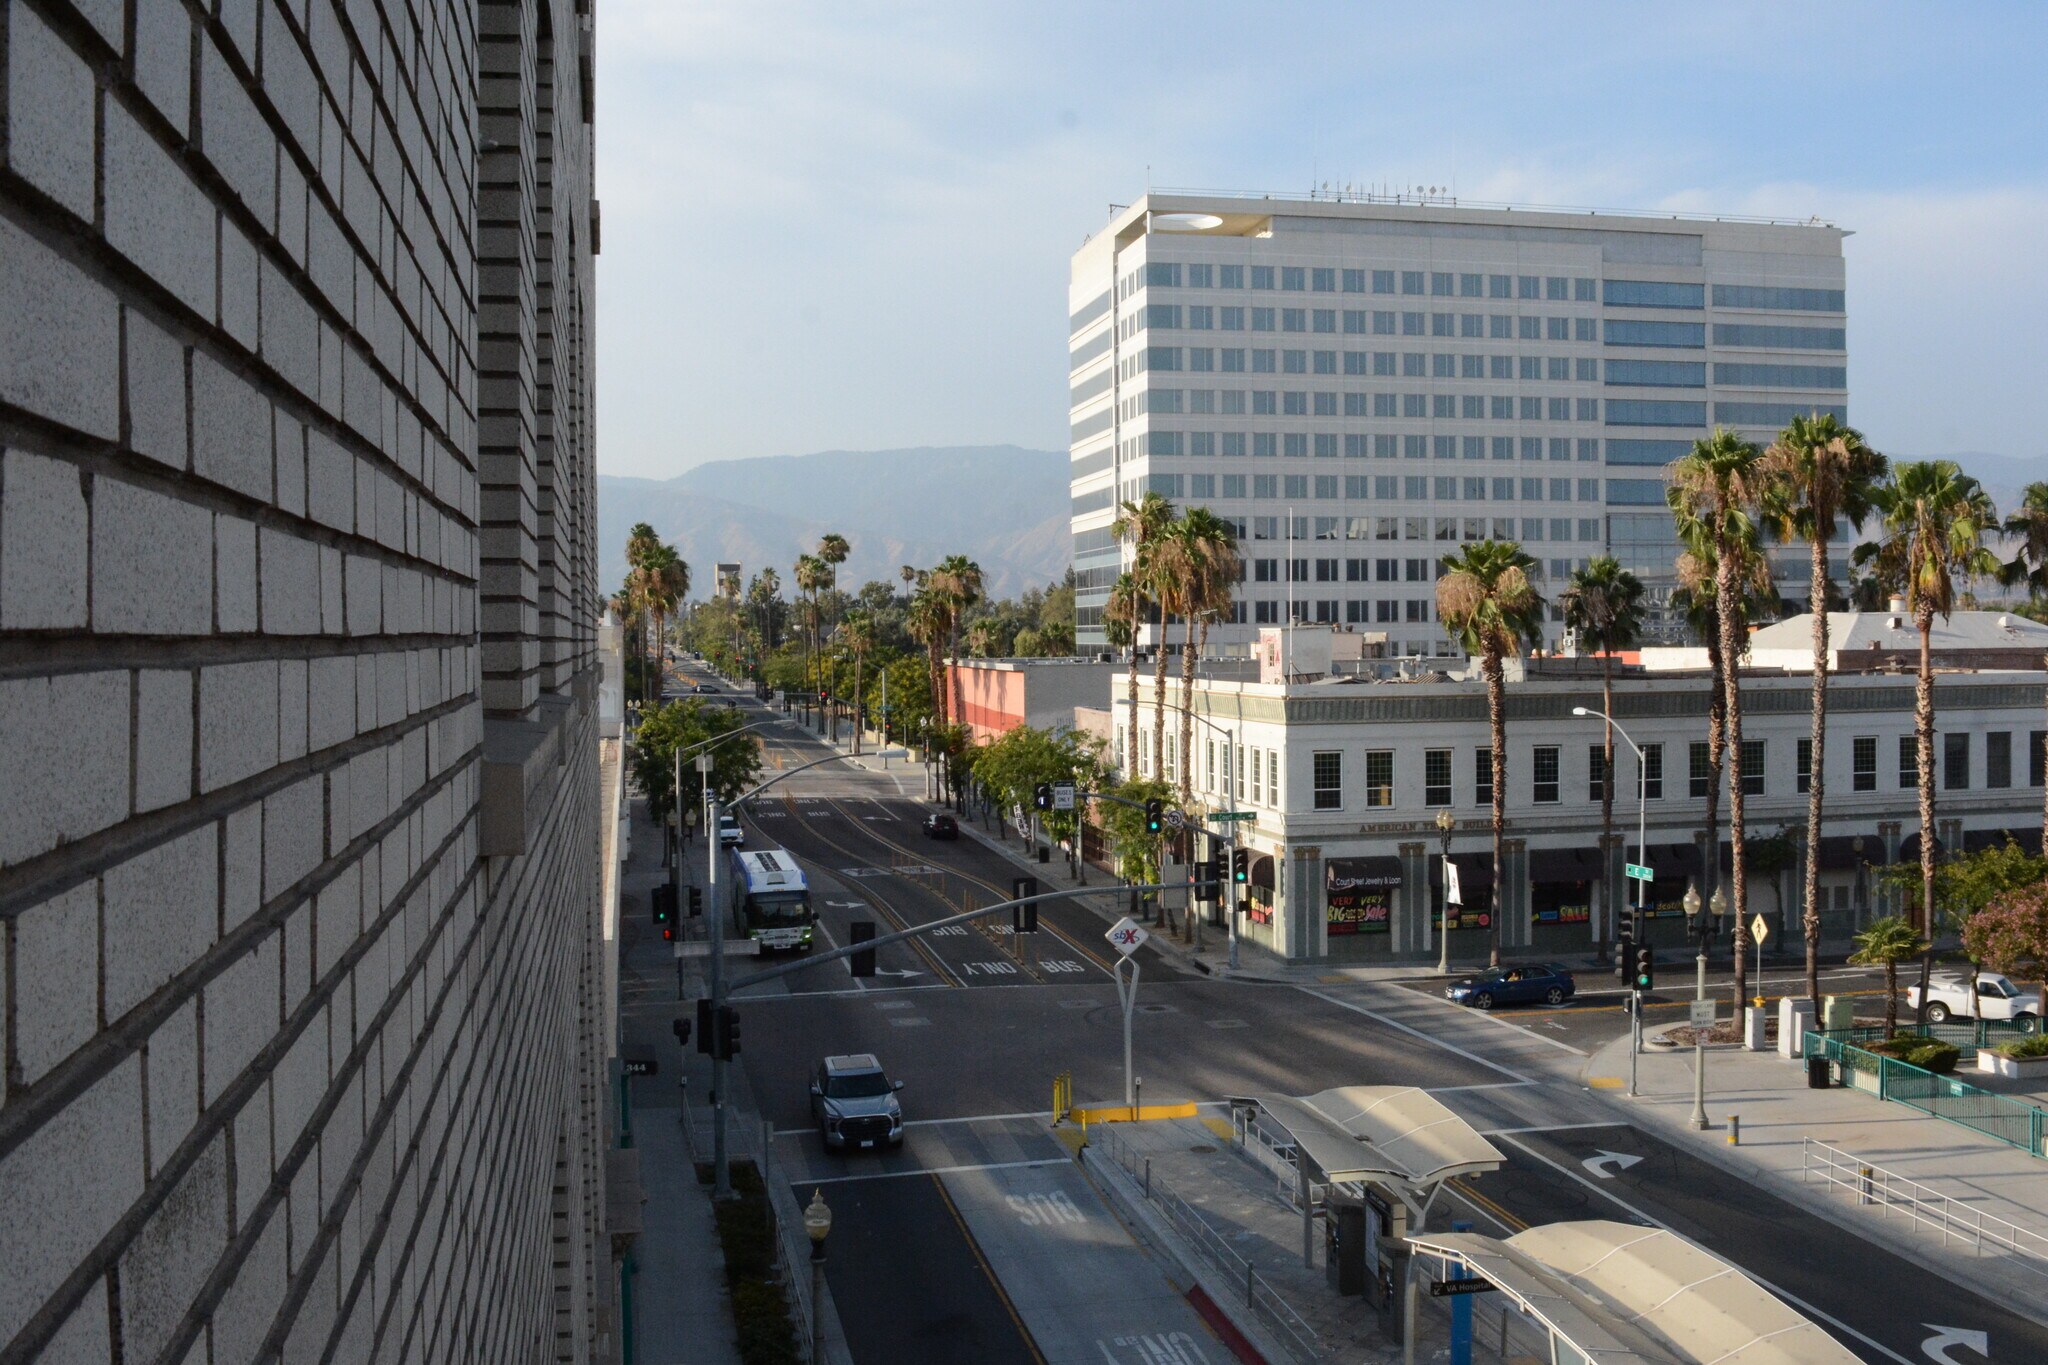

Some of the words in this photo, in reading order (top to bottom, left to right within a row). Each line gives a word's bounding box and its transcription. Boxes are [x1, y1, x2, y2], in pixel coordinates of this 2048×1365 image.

[1359, 822, 1417, 833] AMERICAN
[1350, 877, 1365, 886] Street
[1365, 876, 1384, 886] Jewelry
[1384, 876, 1389, 884] &
[1389, 876, 1402, 884] Loan
[1332, 896, 1355, 906] VERY
[1360, 895, 1385, 906] VERY
[1327, 905, 1345, 921] BIG
[1559, 905, 1589, 922] SALE
[963, 961, 1018, 976] ONLY
[1039, 960, 1085, 973] BUS
[626, 1063, 647, 1071] 344
[1005, 1190, 1088, 1226] BUS
[1446, 1284, 1458, 1293] VA
[1459, 1281, 1491, 1291] Hospital
